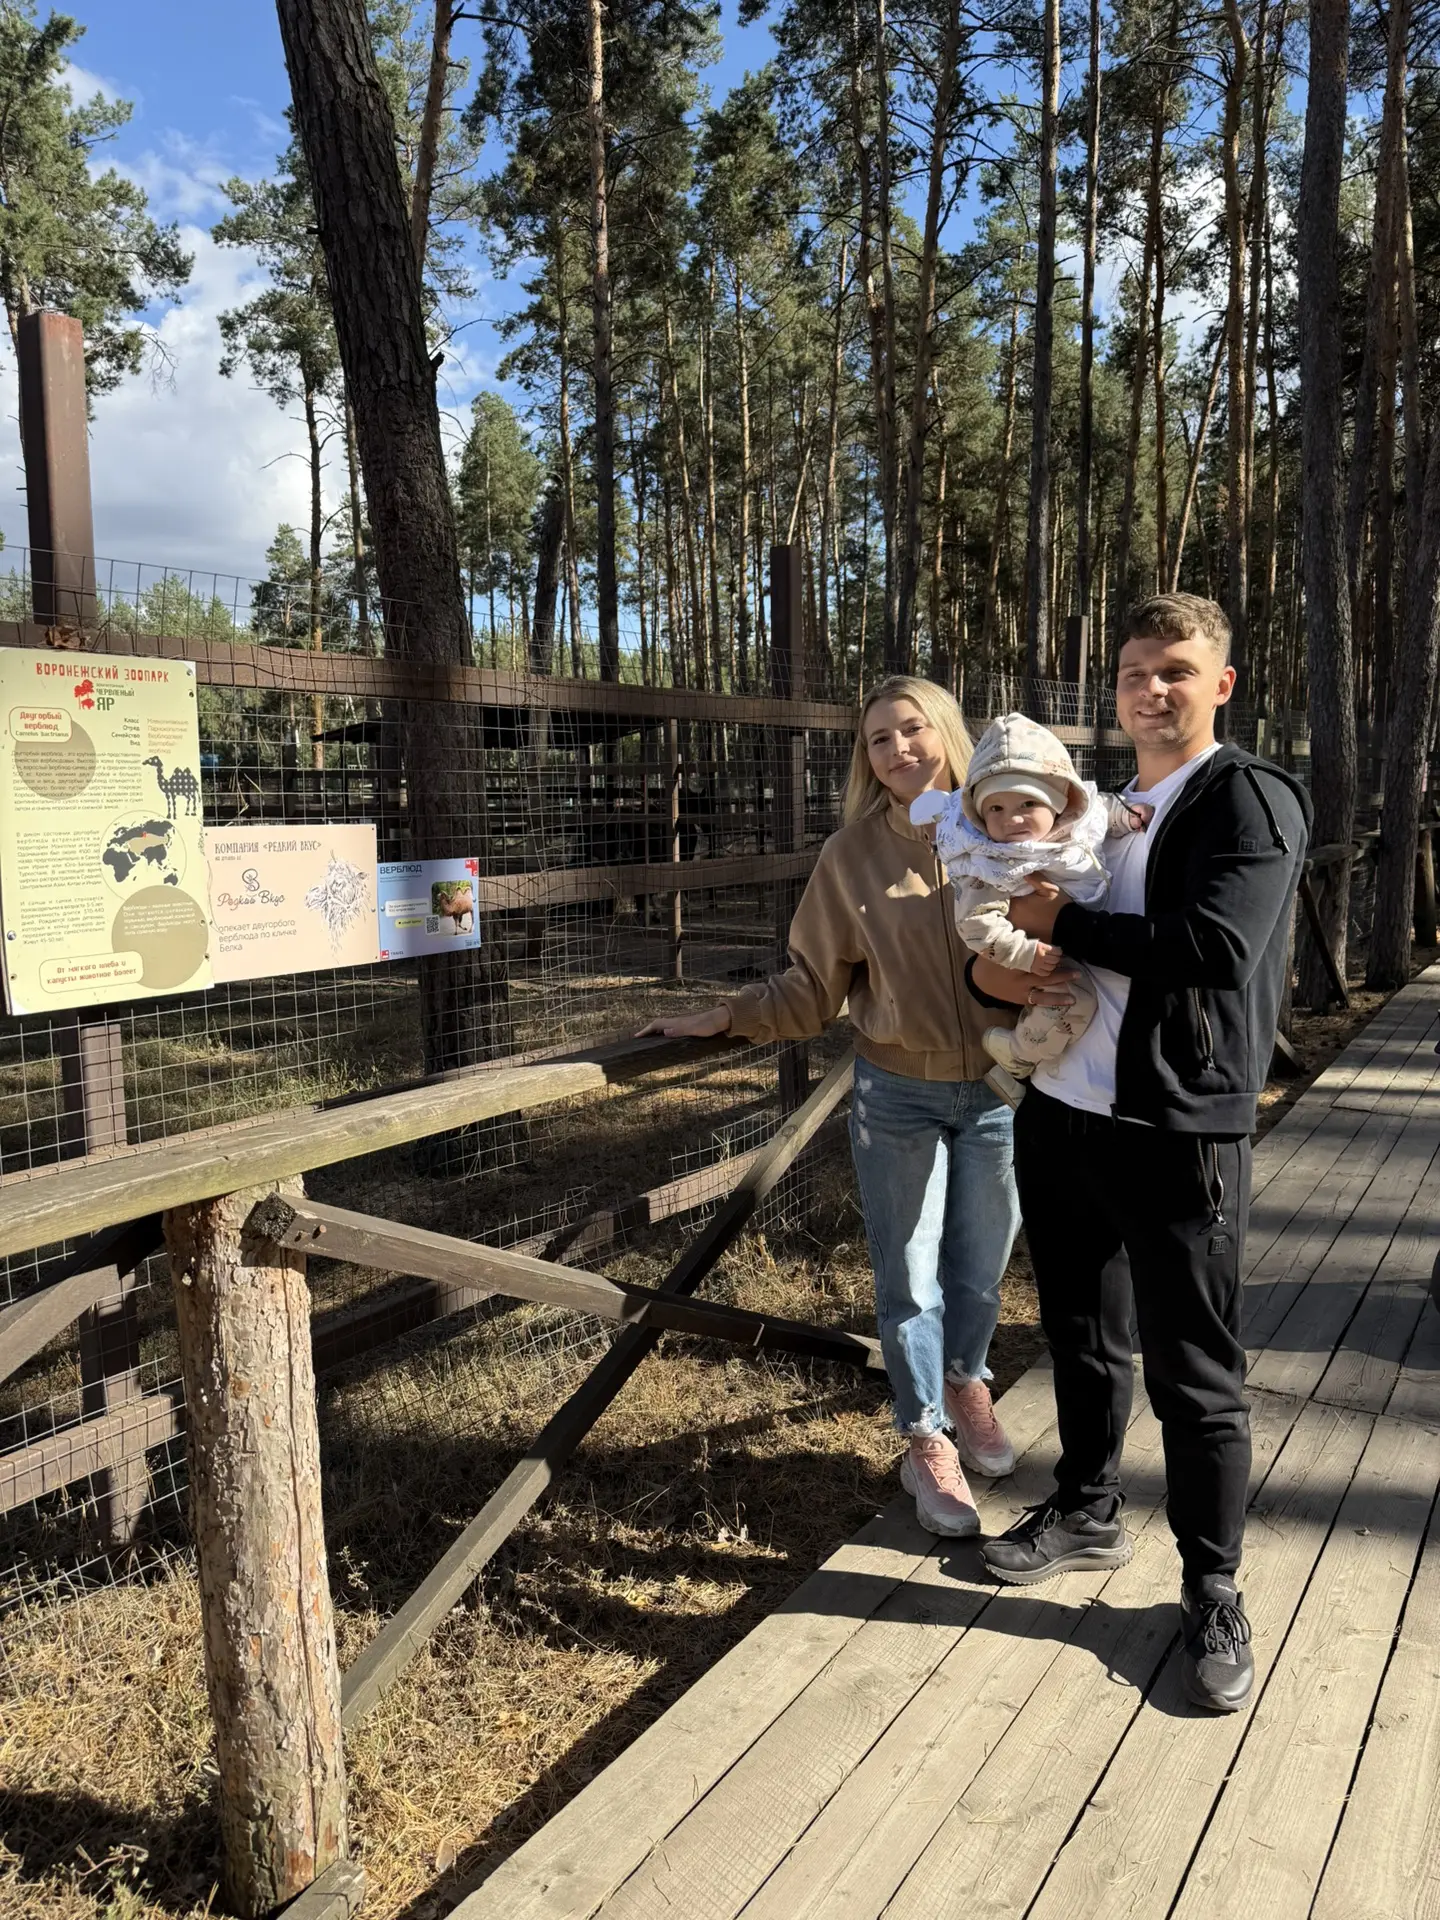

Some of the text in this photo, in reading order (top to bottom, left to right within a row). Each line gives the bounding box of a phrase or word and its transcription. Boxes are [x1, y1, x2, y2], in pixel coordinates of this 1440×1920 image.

[36, 662, 169, 683] ВОРОНЕЖСКИЙ ЗООПАРК
[97, 697, 115, 711] ЯР
[20, 711, 62, 721] Двугорбый
[24, 722, 59, 732] верблюд
[215, 842, 259, 854] КОМПАНИЯ
[380, 864, 423, 875] ВЕРБЛЮД
[218, 919, 295, 933] опекает двугорбого
[219, 932, 259, 943] верблюда
[272, 929, 297, 937] кличке
[219, 943, 243, 952] Белка
